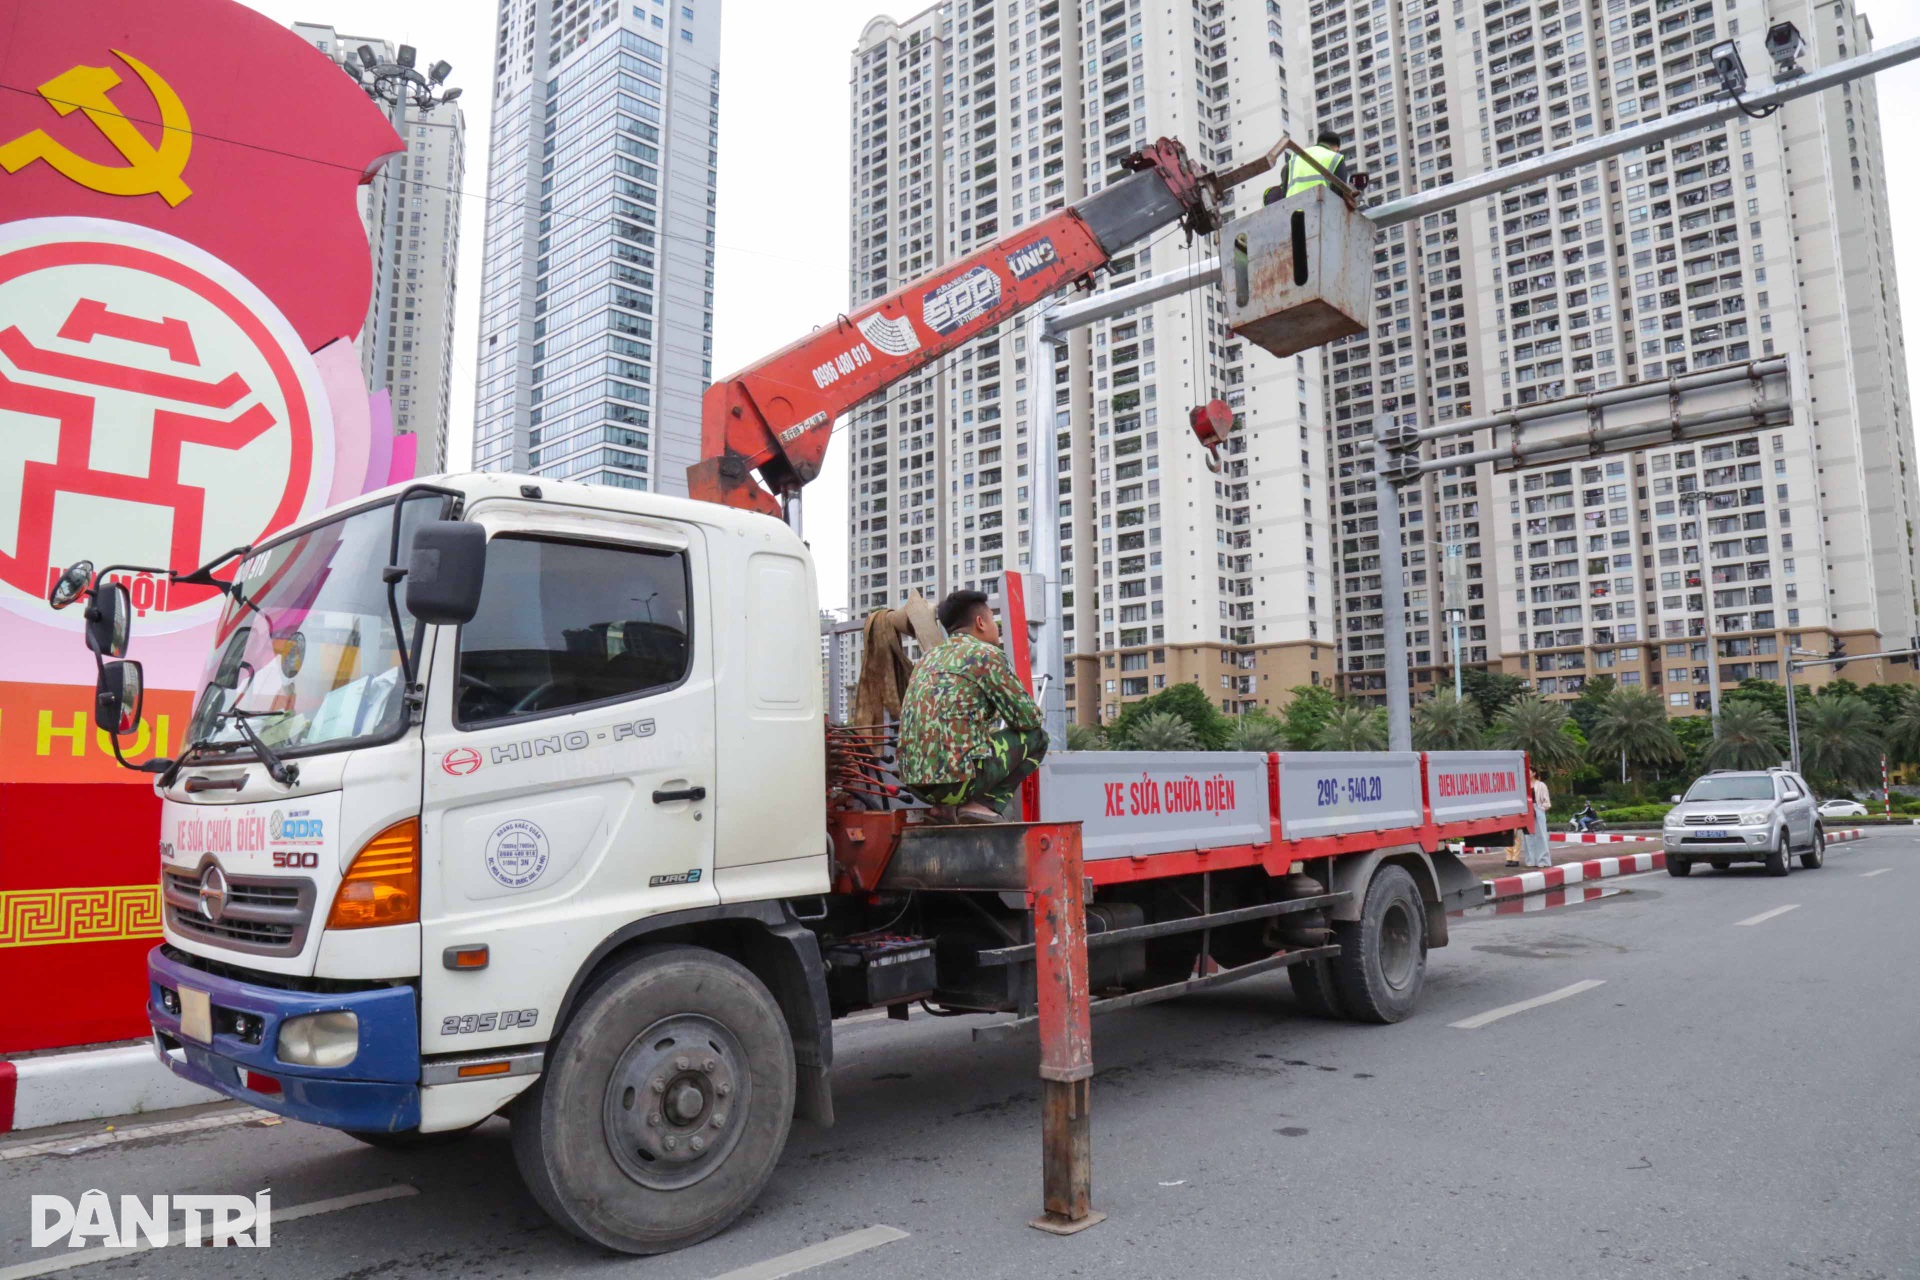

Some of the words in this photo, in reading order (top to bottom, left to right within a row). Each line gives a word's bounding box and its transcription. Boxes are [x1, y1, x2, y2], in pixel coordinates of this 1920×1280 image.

[1010, 242, 1055, 277] UNIC
[929, 269, 994, 325] 500
[812, 361, 839, 389] 0986
[834, 351, 856, 376] 480
[850, 342, 872, 367] 918
[491, 730, 590, 765] HINO
[613, 717, 656, 742] FG
[1104, 782, 1126, 817] XE
[1129, 771, 1161, 816] SỬA
[1164, 775, 1203, 814] CHỮA
[1317, 778, 1339, 807] 29C
[1348, 776, 1383, 804] 540.20
[177, 820, 187, 851] XE
[282, 819, 324, 840] QDR
[273, 852, 320, 869] 500
